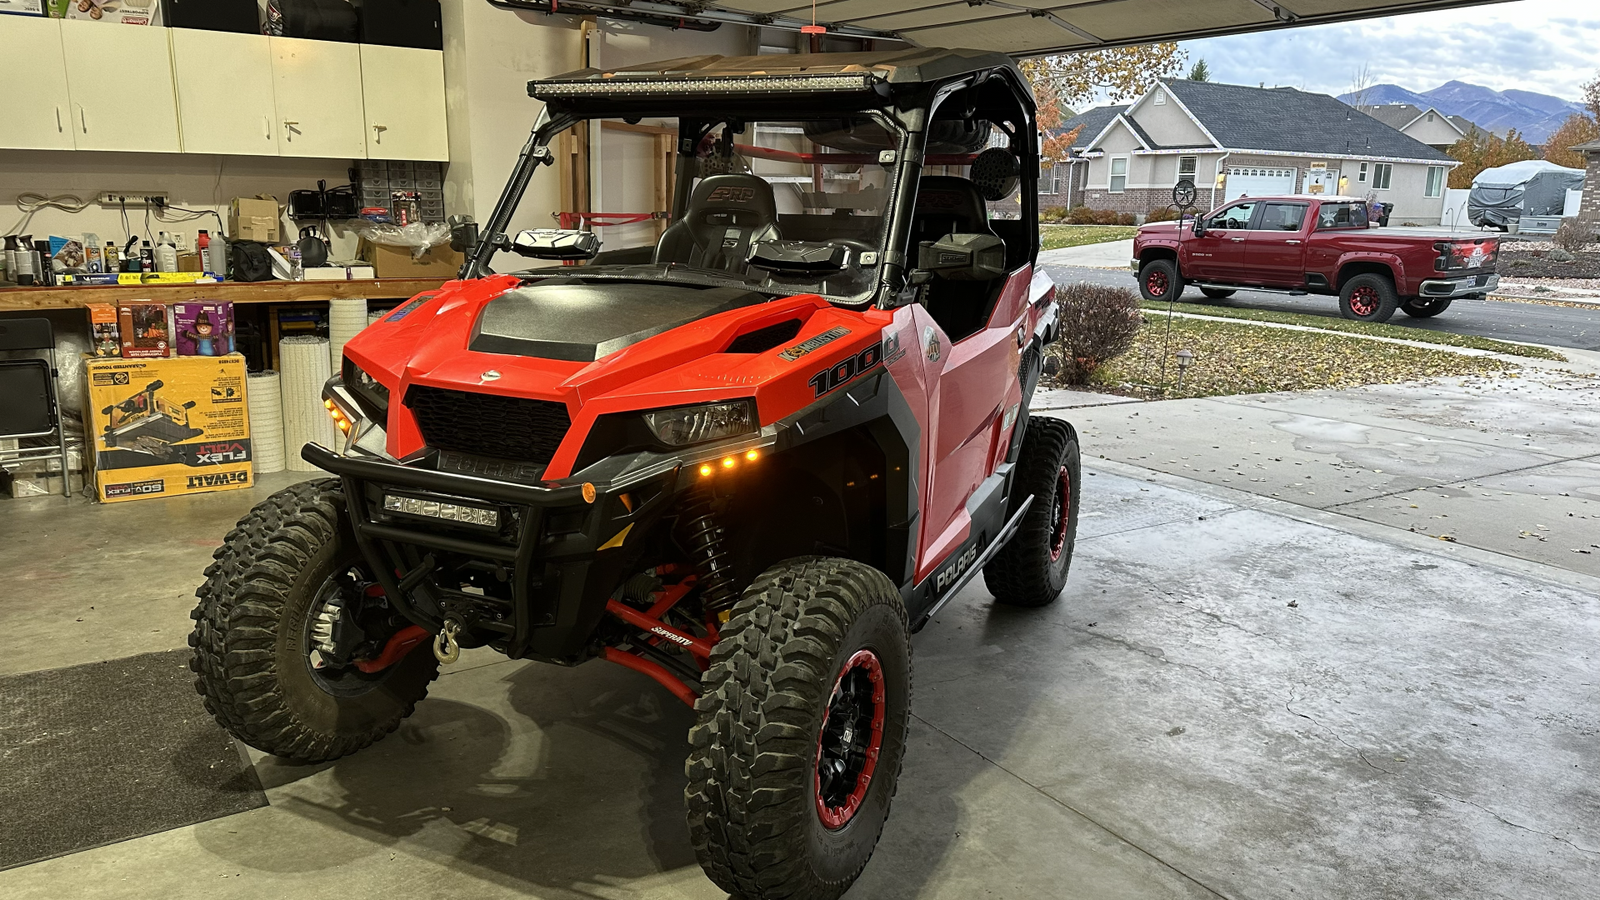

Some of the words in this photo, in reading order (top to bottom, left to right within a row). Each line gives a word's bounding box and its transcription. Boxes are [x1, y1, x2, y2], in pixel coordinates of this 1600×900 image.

[808, 330, 900, 400] 1000
[196, 443, 245, 455] VOLT
[196, 450, 247, 464] FLEX
[442, 454, 538, 481] POLARIS
[186, 472, 248, 489] DEWALT
[107, 487, 131, 496] FLEX
[937, 543, 977, 593] POLARIS
